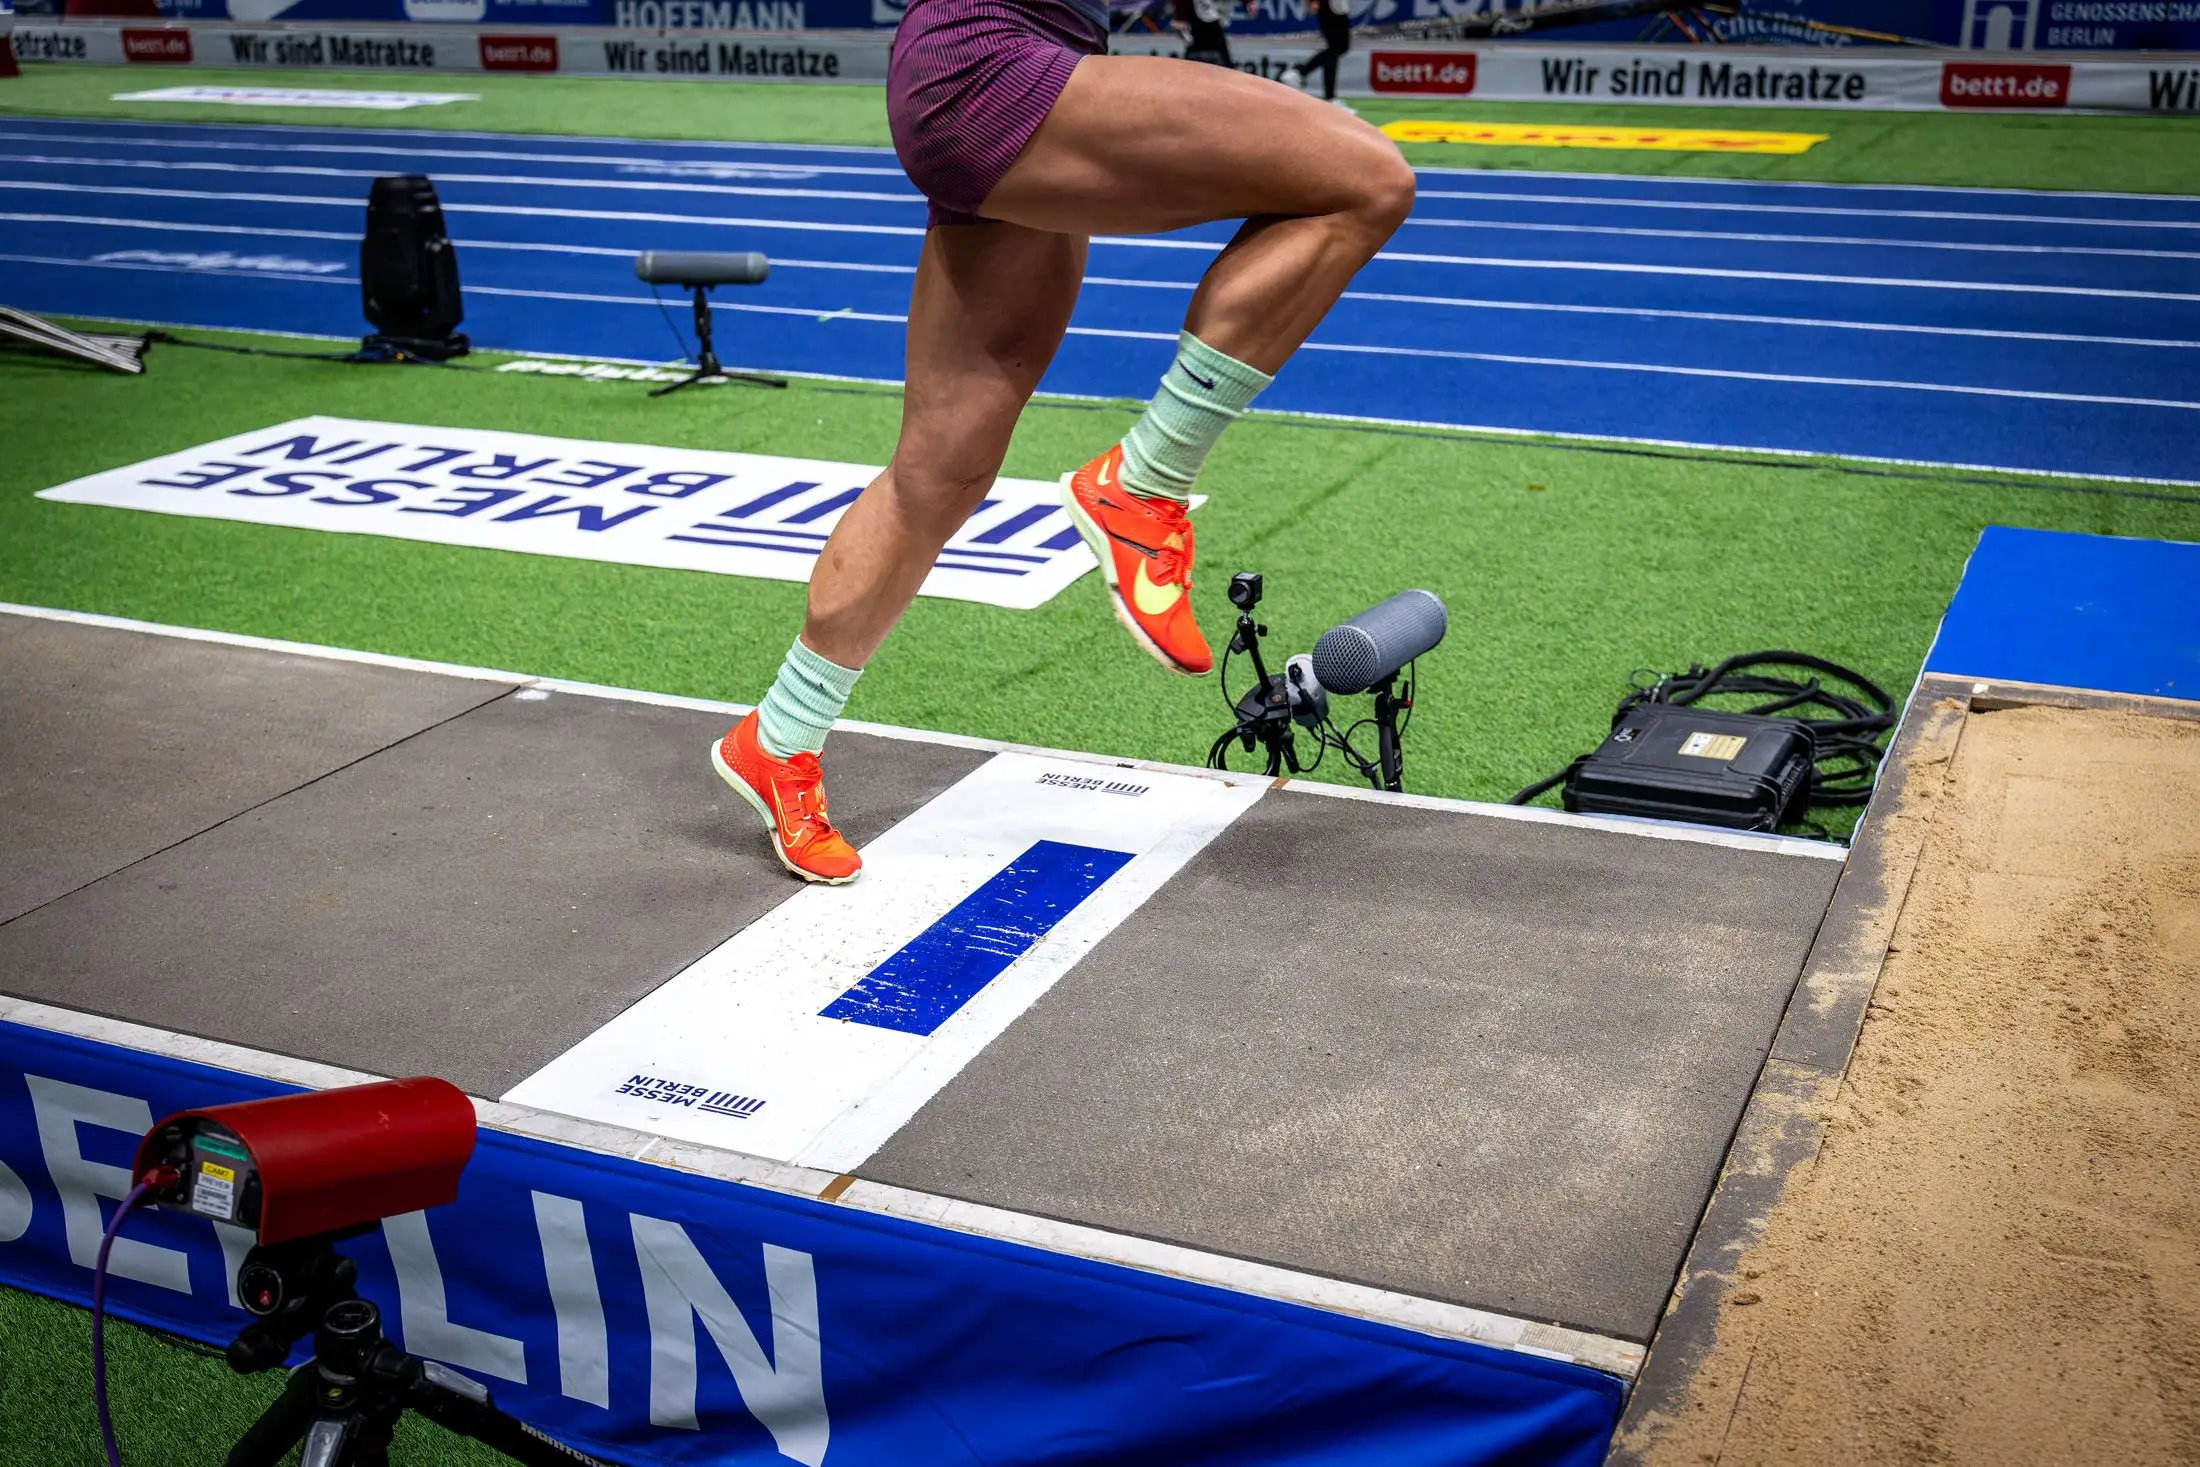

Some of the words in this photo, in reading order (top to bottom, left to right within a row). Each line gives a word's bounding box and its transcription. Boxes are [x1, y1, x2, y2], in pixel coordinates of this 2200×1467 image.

[615, 1, 804, 29] HOFFMANN
[14, 32, 87, 59] atratze
[2048, 27, 2116, 46] BERLIN
[229, 34, 268, 63] Wir
[275, 33, 324, 65] sind
[329, 35, 435, 67] Matratze
[603, 41, 647, 72] Wir
[655, 41, 710, 74] sind
[719, 43, 839, 77] Matratze
[1376, 60, 1468, 84] bett1.de
[1542, 57, 1600, 95] Wir
[1609, 58, 1686, 97] sind
[1698, 61, 1866, 99] Matratze
[1950, 74, 2060, 98] bett1.de
[241, 436, 736, 498] BERLIN
[139, 462, 659, 532] MESSE
[1035, 777, 1098, 791] MESSE
[1042, 772, 1104, 786] BERLIN
[615, 1084, 698, 1108] MESSE
[628, 1074, 709, 1098] BERLIN
